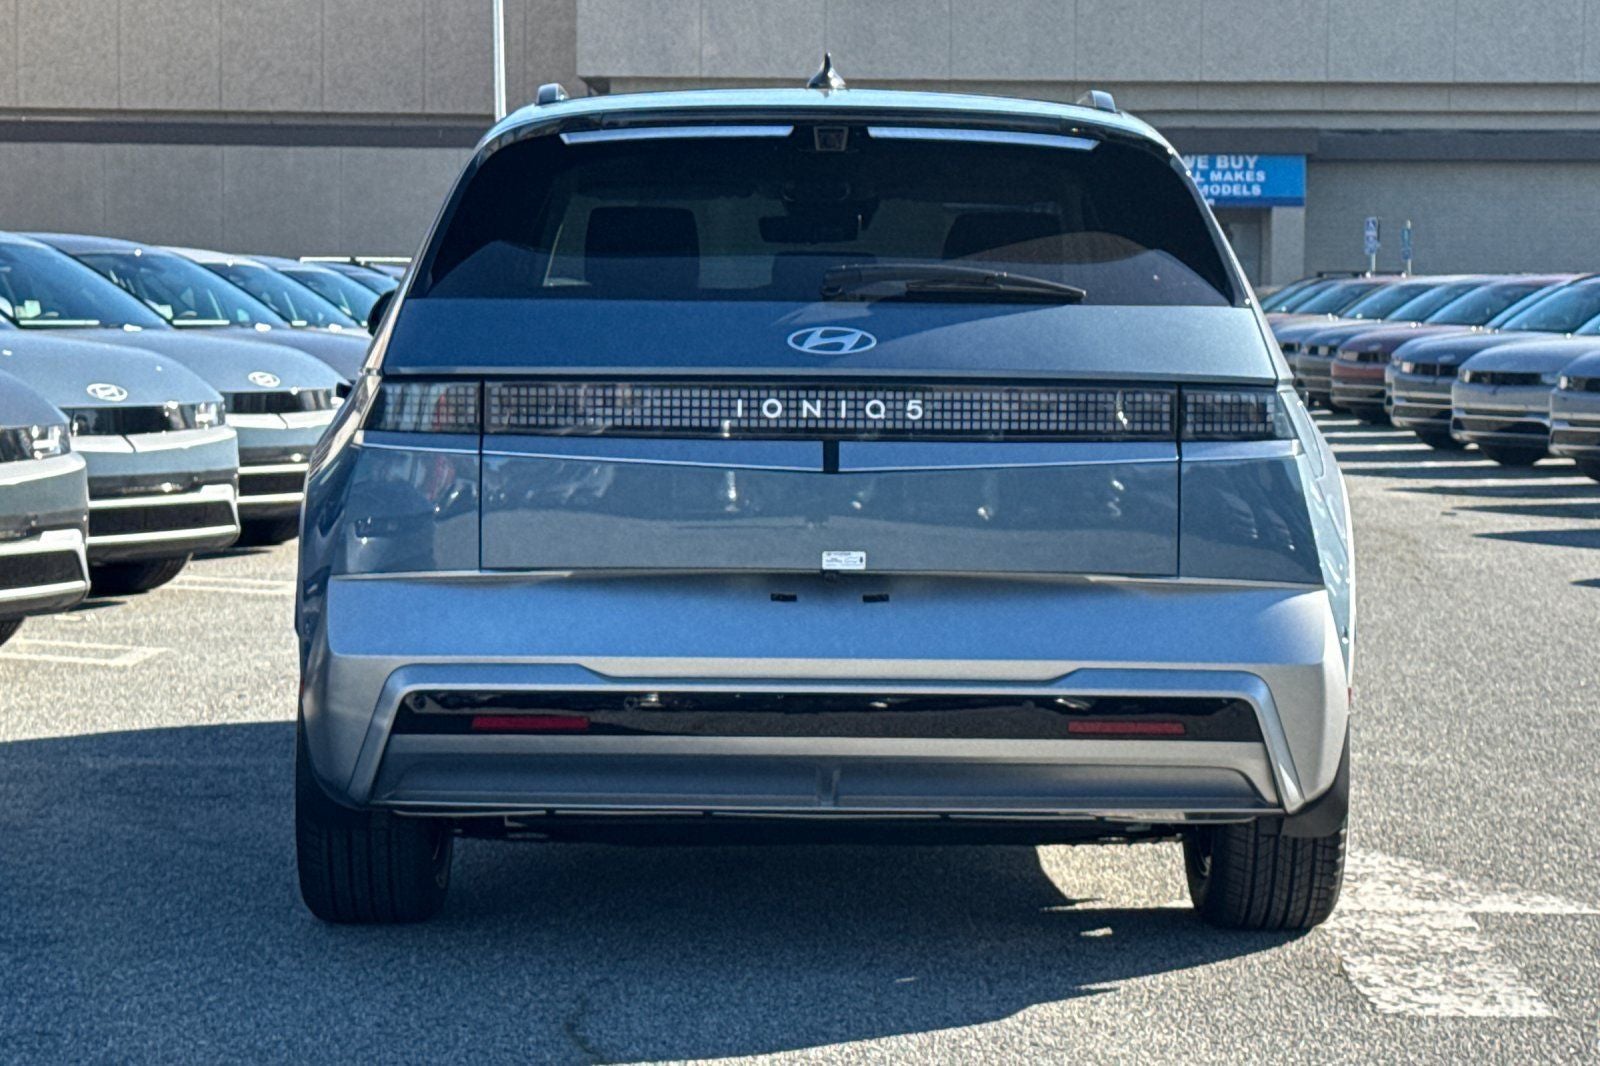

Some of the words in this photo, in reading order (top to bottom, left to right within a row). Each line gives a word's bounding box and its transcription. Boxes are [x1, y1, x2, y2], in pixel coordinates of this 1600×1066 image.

[1216, 154, 1258, 169] BUY
[1210, 170, 1265, 182] MAKES
[736, 398, 886, 420] IONIQ
[906, 399, 924, 420] 5
